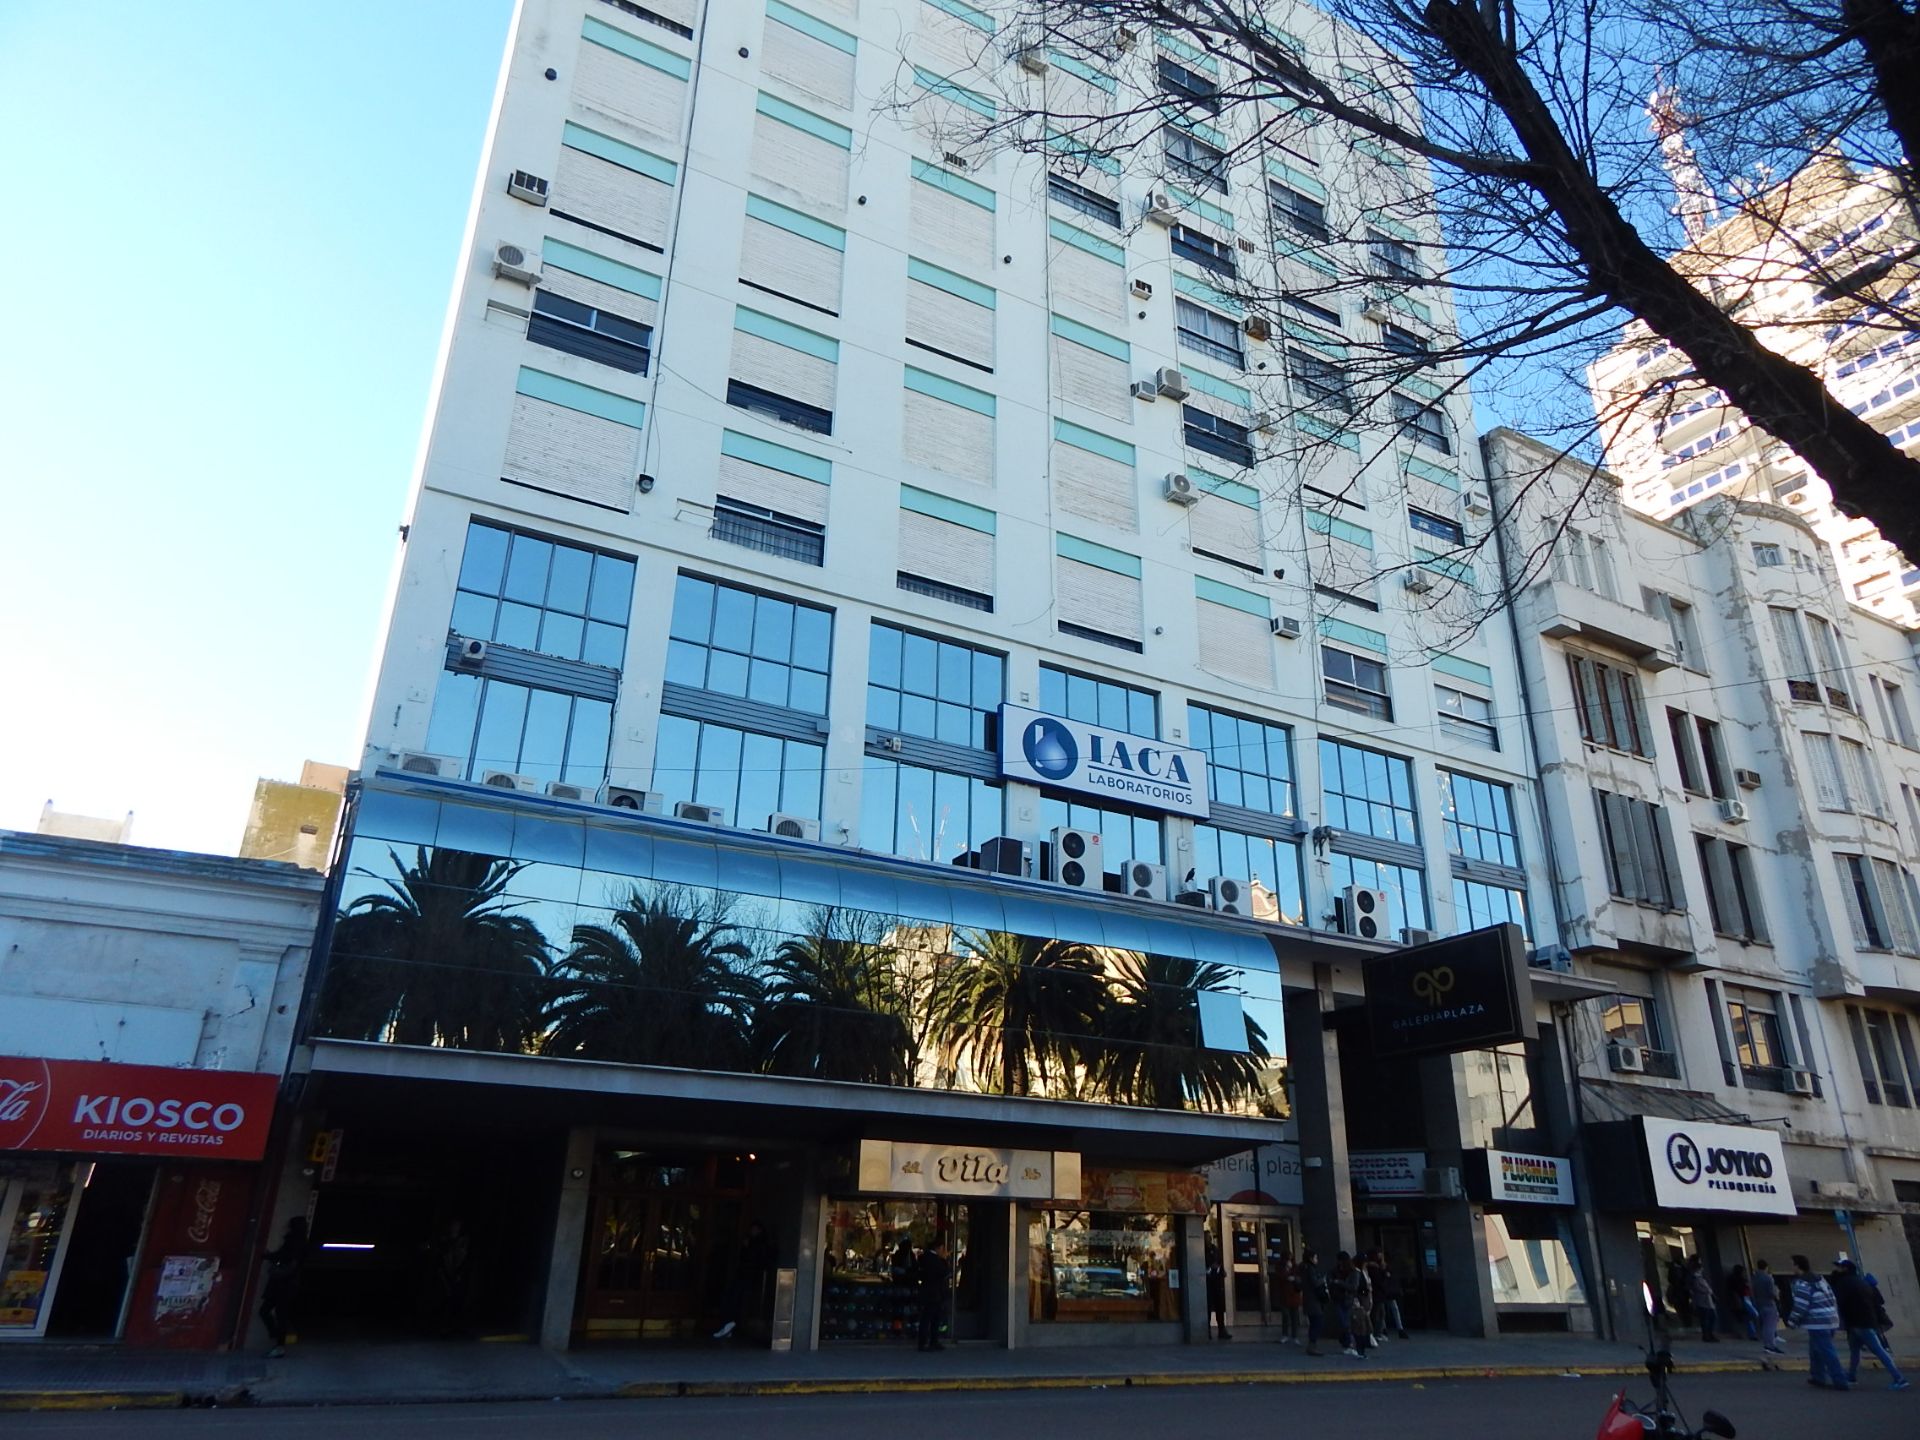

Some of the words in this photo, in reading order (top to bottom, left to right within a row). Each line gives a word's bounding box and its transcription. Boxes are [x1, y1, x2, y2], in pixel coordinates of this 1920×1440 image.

[1088, 734, 1190, 784] IACA
[1088, 772, 1193, 805] LABORATORIOS
[73, 1095, 245, 1131] KIOSCO
[83, 1129, 143, 1141] DIARIOS
[146, 1132, 156, 1142] Y
[159, 1132, 224, 1145] REVISTAS
[1348, 1157, 1409, 1168] ONDOR
[1705, 1147, 1773, 1178] JOYKO
